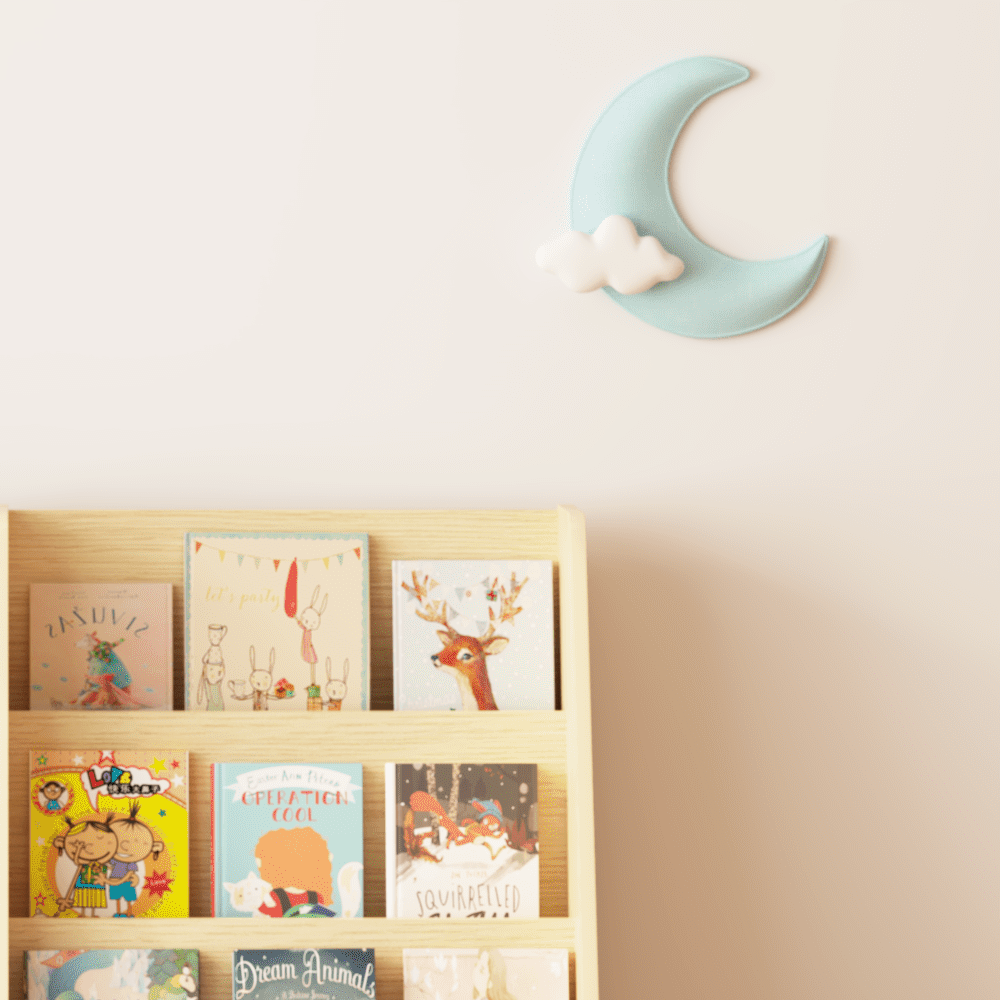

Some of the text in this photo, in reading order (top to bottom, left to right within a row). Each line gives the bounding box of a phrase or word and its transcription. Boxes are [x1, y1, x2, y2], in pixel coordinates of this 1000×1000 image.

[241, 790, 348, 806] OPERATION
[272, 807, 317, 822] COOL
[416, 883, 520, 918] SQUIRRELLED
[235, 948, 375, 1000] Dream Animals
